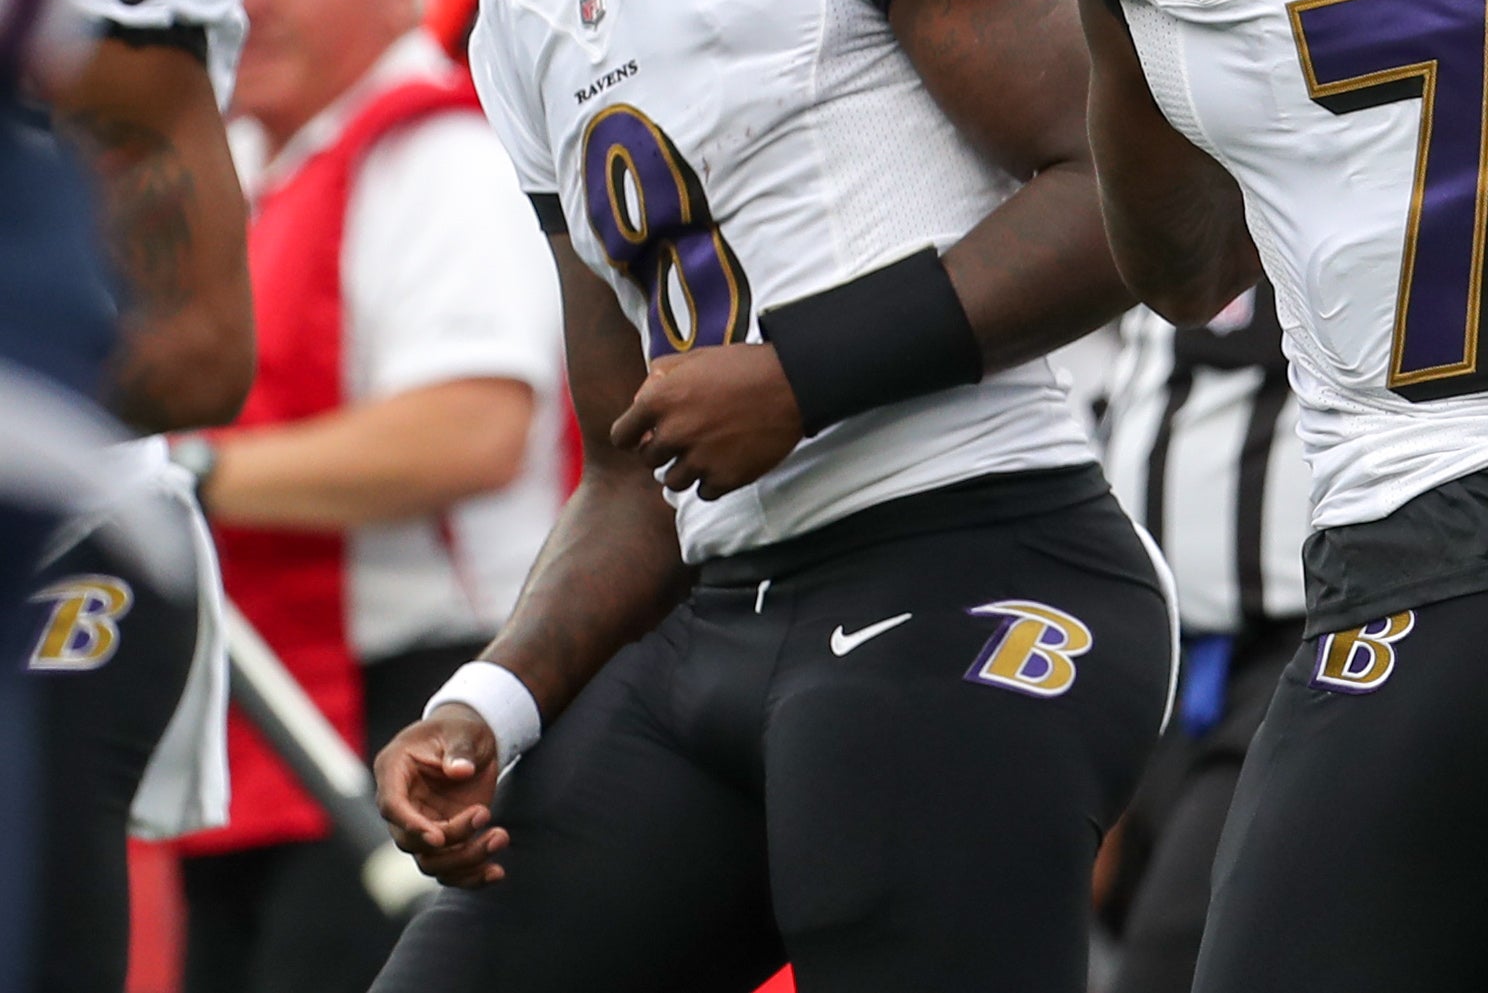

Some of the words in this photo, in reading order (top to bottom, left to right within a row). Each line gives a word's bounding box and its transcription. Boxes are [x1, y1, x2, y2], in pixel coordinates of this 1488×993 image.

[573, 58, 639, 105] RAVENS
[580, 102, 753, 360] 8
[26, 573, 136, 673] B
[964, 598, 1094, 699] B
